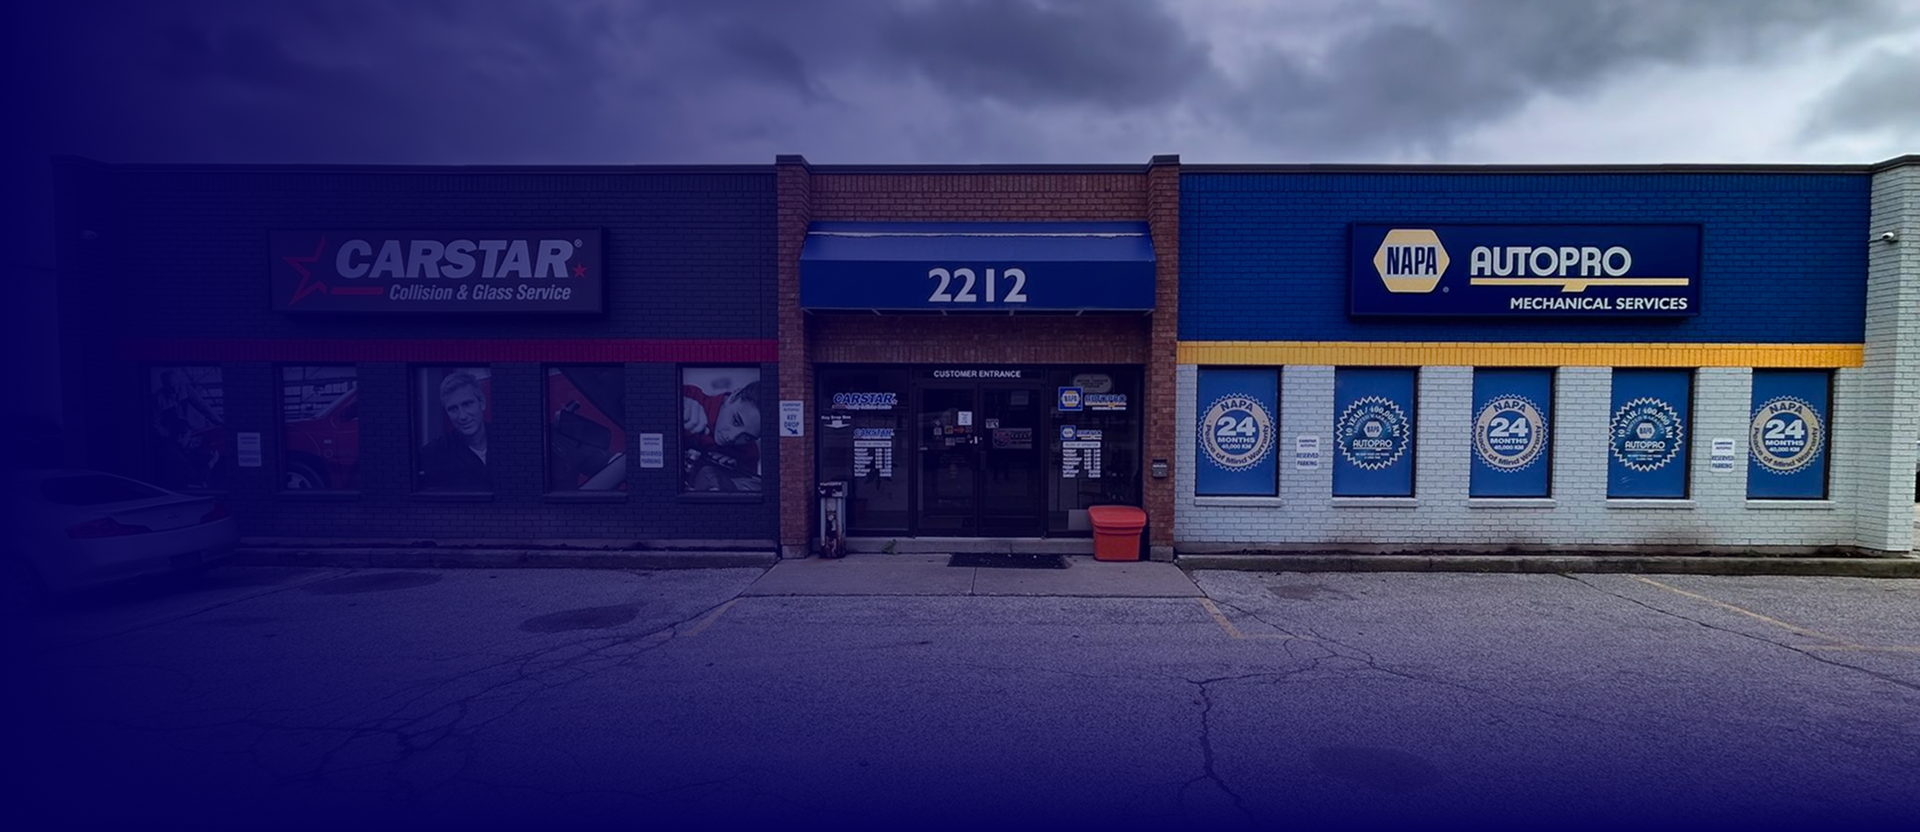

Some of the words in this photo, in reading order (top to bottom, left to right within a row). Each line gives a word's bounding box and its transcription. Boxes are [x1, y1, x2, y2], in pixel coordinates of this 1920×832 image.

[335, 239, 574, 279] CARSTAR
[1387, 246, 1437, 275] NAPA
[1470, 246, 1632, 277] AUTOPRO
[389, 283, 451, 300] Collision
[457, 284, 468, 300] &
[472, 283, 513, 300] Glass
[516, 283, 571, 300] Service
[928, 267, 1028, 303] 2212
[1510, 297, 1612, 310] MECHANICAL
[1615, 297, 1688, 310] SERVICES
[933, 370, 977, 378] CUSTOMER
[978, 370, 1021, 378] ENTRANCE
[833, 392, 893, 404] CARSTAR
[1220, 400, 1253, 412] NAPA
[1493, 401, 1526, 412] NAPA
[1769, 402, 1802, 414] NAPA
[1347, 409, 1364, 426] YEAR
[1620, 410, 1638, 427] YEAR
[1217, 416, 1256, 436] 24
[1489, 417, 1528, 437] 24
[1764, 419, 1805, 439] 24
[1352, 439, 1393, 448] AUTOPRO
[1624, 441, 1666, 449] AUTOPRO
[1215, 452, 1225, 461] of
[1763, 456, 1773, 464] of
